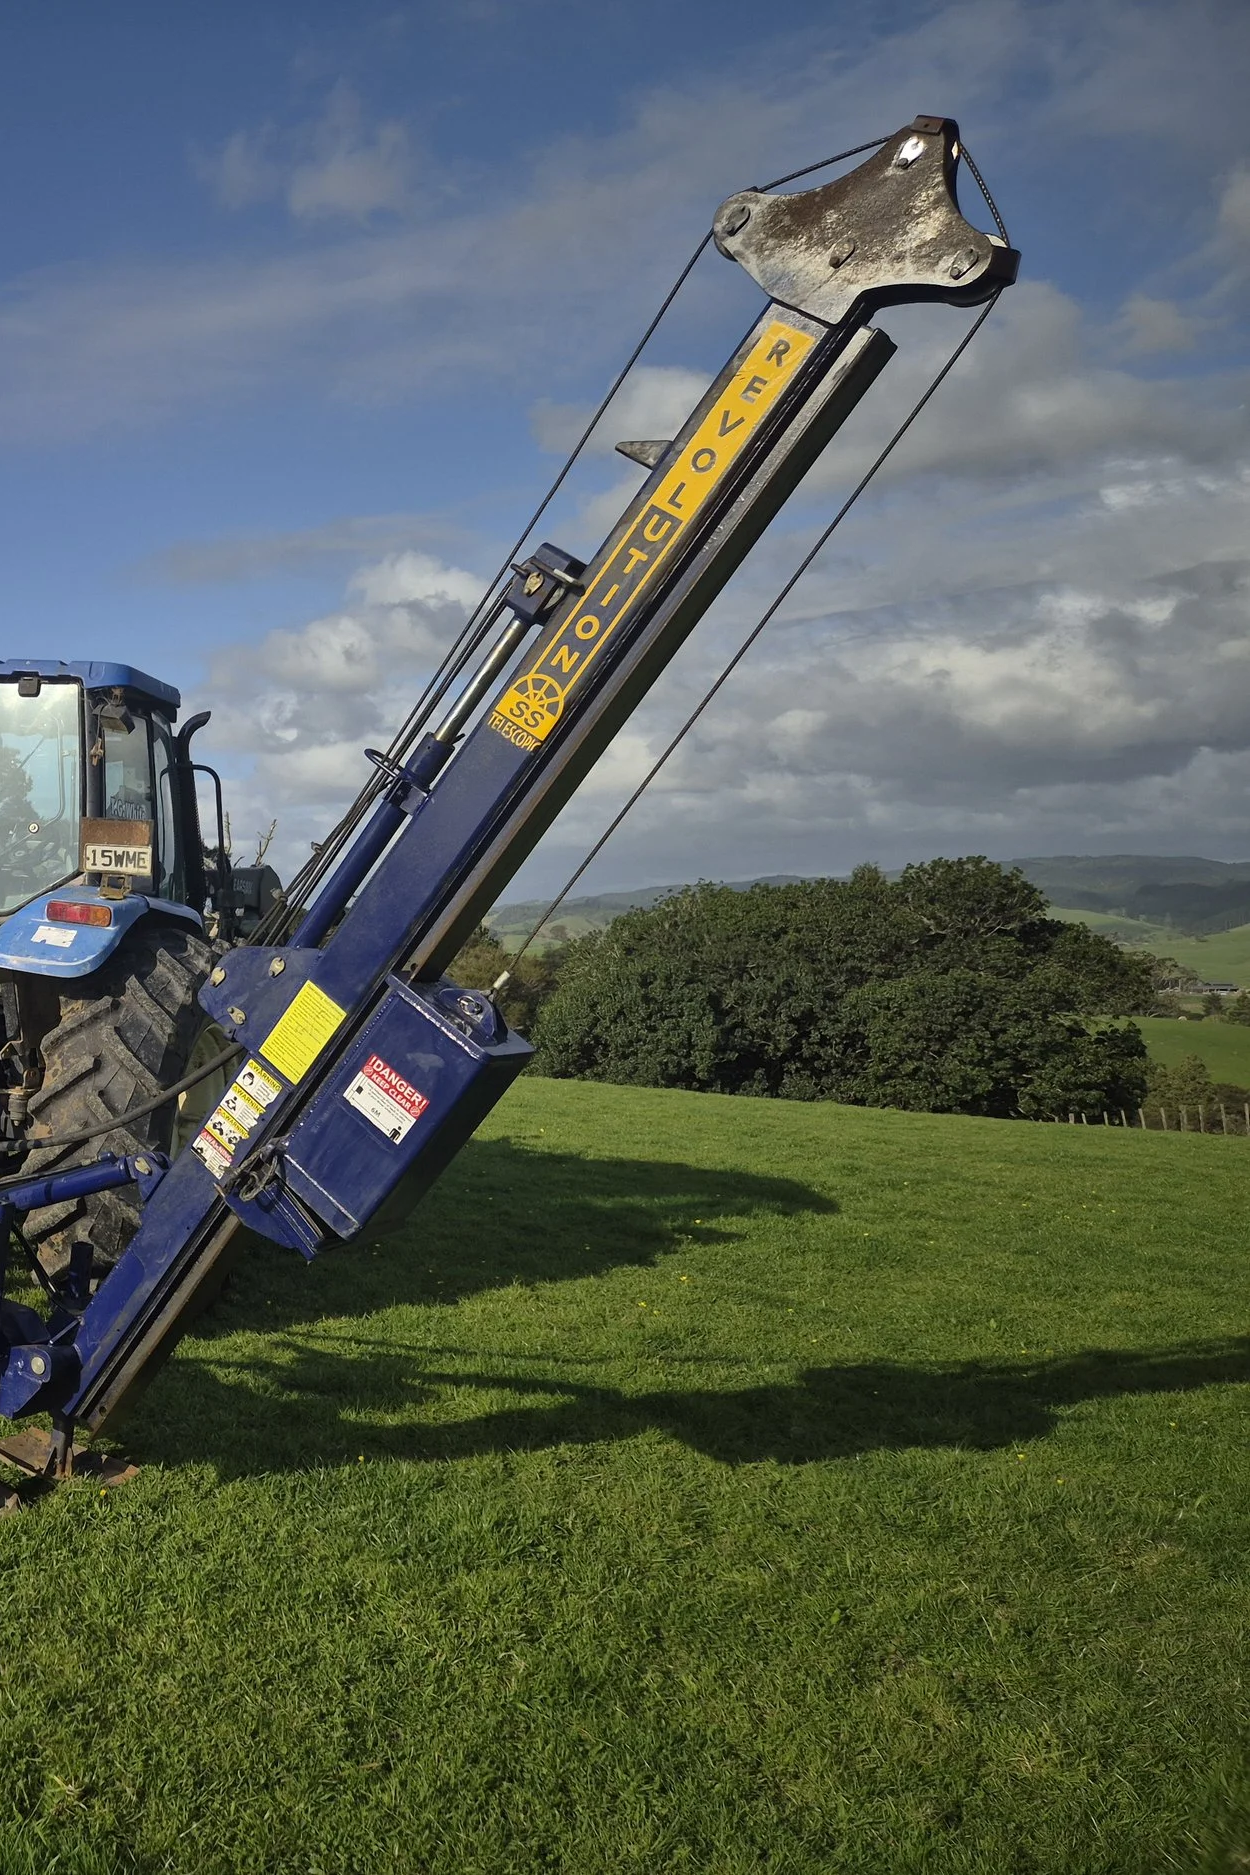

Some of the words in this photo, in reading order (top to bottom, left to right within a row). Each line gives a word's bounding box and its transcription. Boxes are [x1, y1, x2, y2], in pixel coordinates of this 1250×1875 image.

[551, 338, 791, 673] REVOLUTION
[509, 700, 545, 729] SS
[91, 849, 148, 869] 15WME
[253, 1066, 281, 1092] WARNING
[371, 1073, 390, 1090] KEEP
[388, 1088, 412, 1110] CLEAR
[237, 1088, 264, 1114] WARNING
